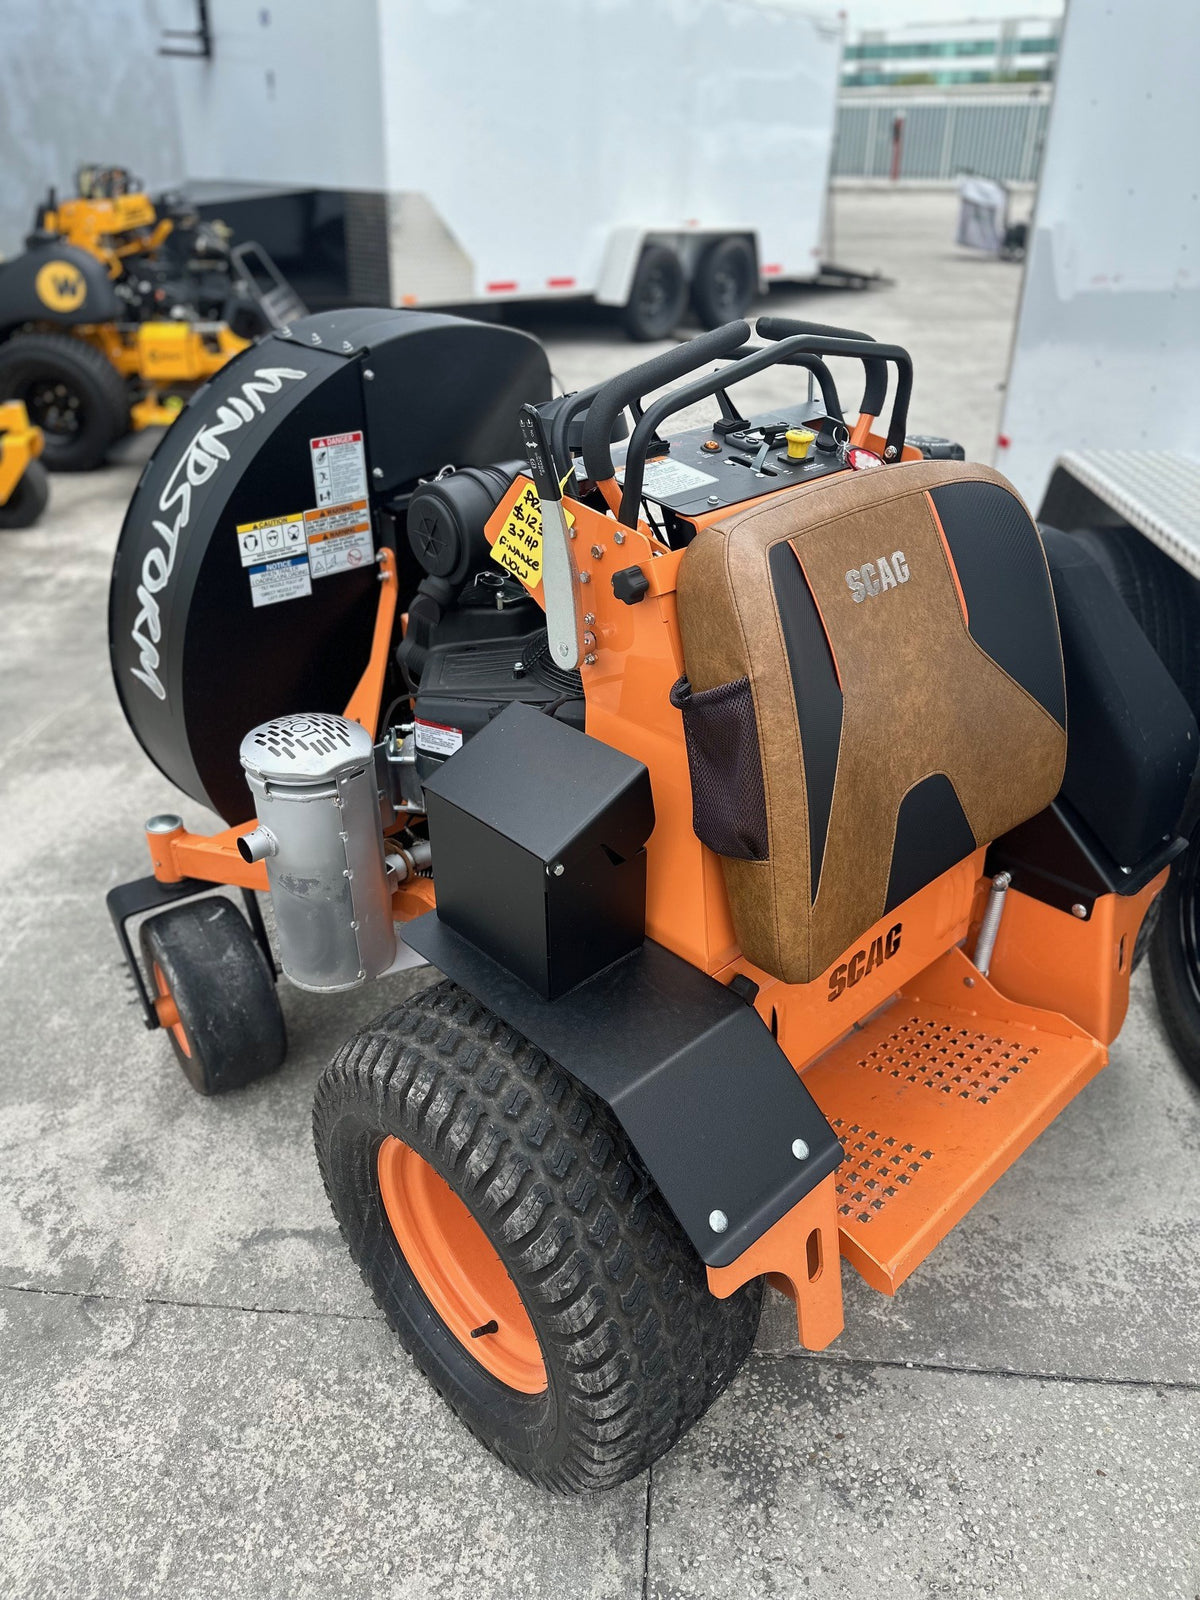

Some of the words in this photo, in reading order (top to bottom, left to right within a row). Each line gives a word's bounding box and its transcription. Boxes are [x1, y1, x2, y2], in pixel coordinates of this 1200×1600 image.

[326, 435, 353, 446] DANGER
[131, 367, 307, 700] WINDSTORM
[259, 517, 288, 529] CAUTION
[508, 523, 525, 541] 32
[524, 535, 539, 551] HP
[266, 559, 292, 571] NOTICE
[501, 553, 528, 580] NOW
[845, 550, 911, 603] SCAG
[280, 718, 322, 738] HOT
[827, 922, 903, 1002] SCAG
